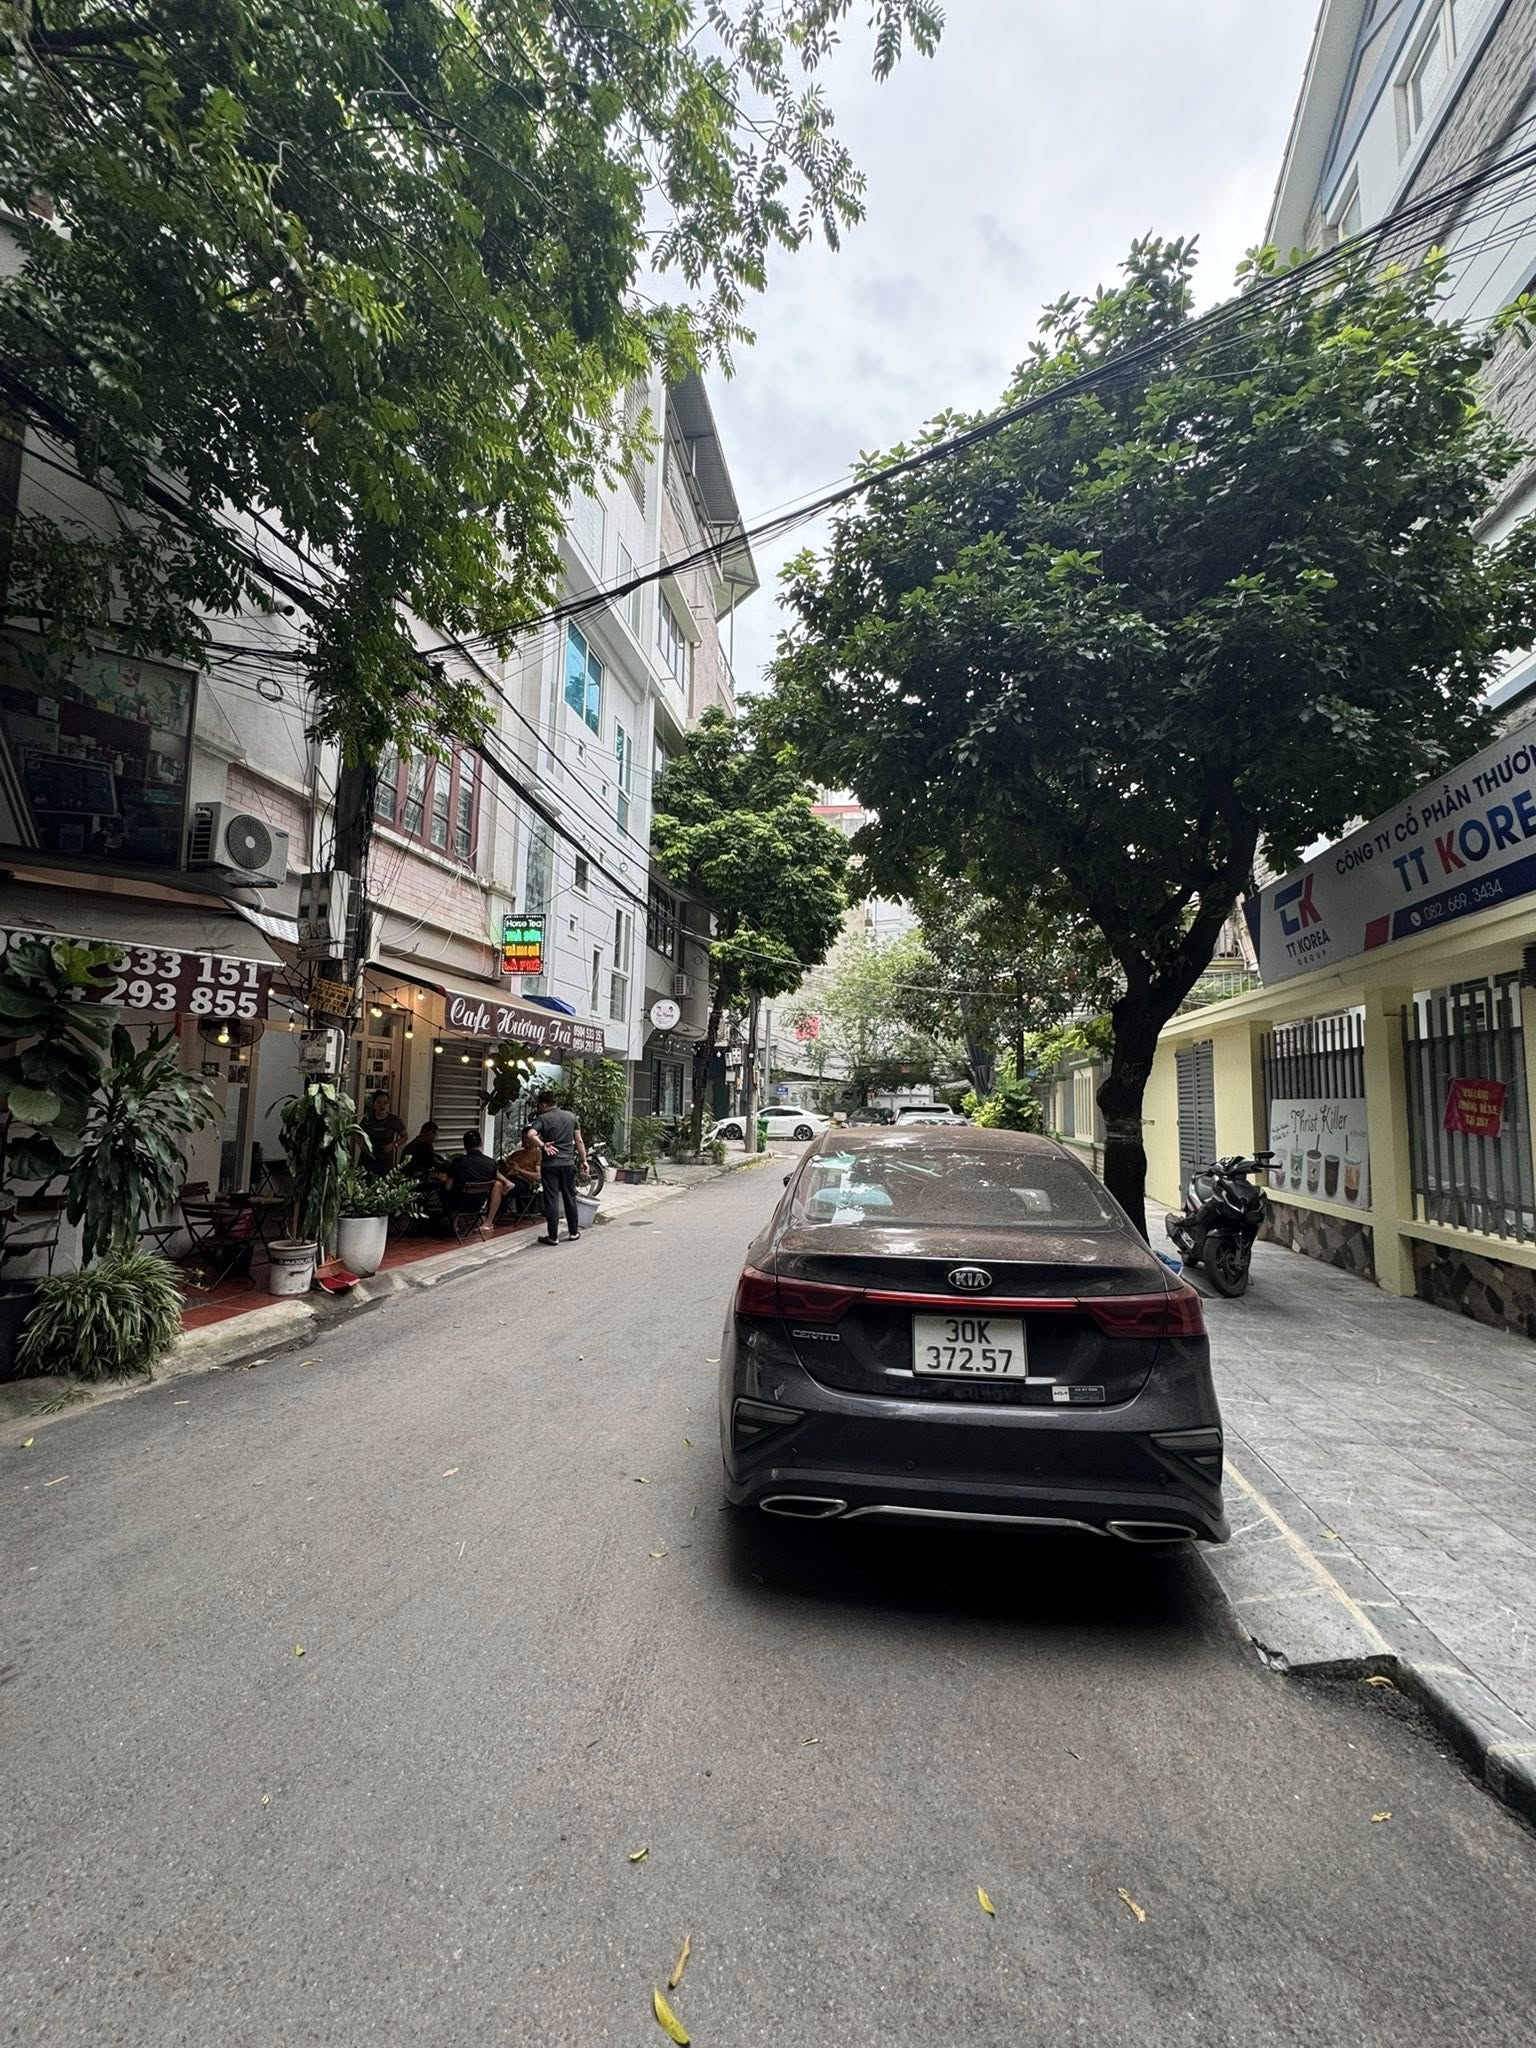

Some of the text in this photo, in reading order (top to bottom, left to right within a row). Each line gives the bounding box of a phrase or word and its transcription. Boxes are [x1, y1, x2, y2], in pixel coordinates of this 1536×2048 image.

[1335, 844, 1374, 876] CÔNG
[1374, 830, 1392, 853] TY
[1394, 805, 1419, 842] CỔ
[1423, 785, 1472, 829] PHẦN
[1392, 846, 1430, 893] TT
[1472, 879, 1503, 901] 3434
[1286, 929, 1331, 958] TT KOREA
[197, 956, 260, 988] 151
[100, 977, 177, 1011] 293
[189, 986, 258, 1018] 855
[450, 997, 572, 1045] Cafe Hương Trà
[1320, 1104, 1348, 1134] Killer
[956, 1272, 985, 1286] KIA
[792, 1329, 841, 1342] CERATO
[946, 1319, 991, 1344] 30K
[926, 1346, 1013, 1373] 372.57
